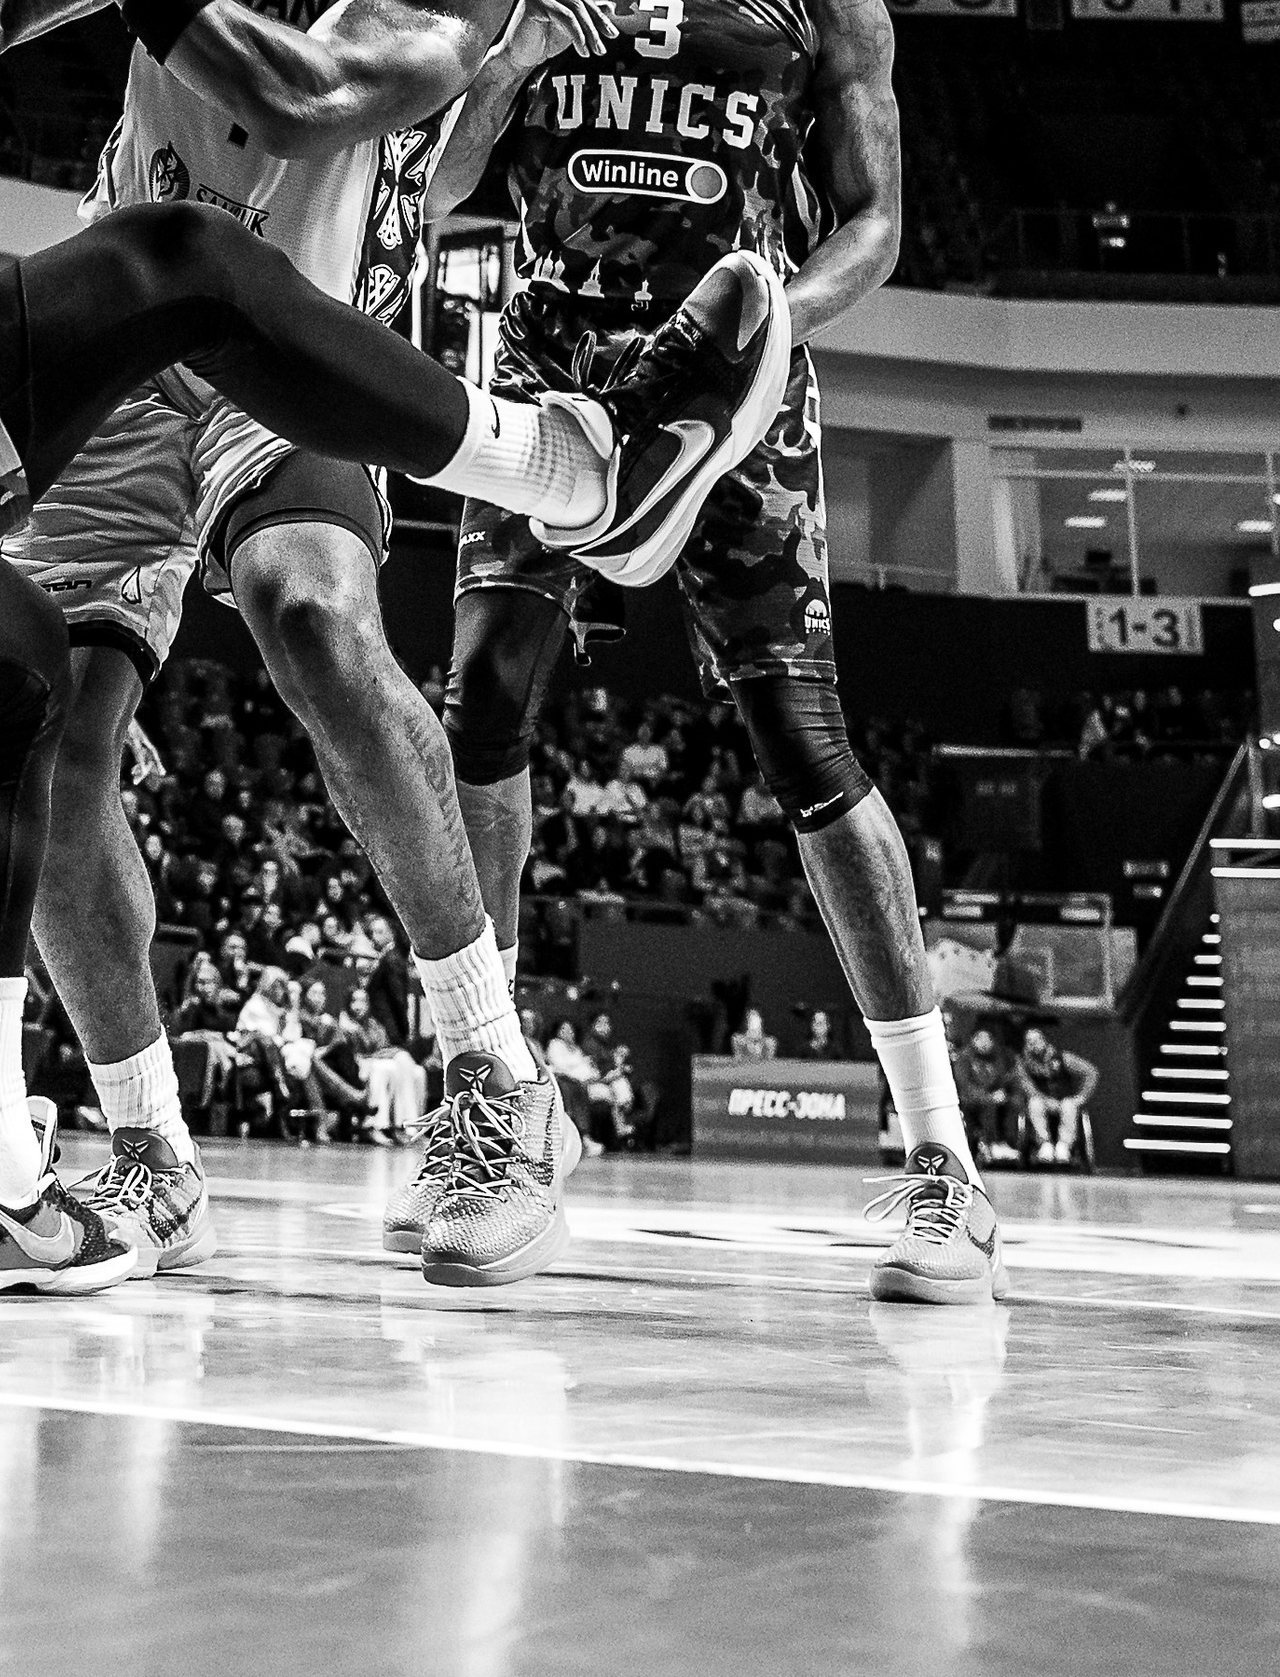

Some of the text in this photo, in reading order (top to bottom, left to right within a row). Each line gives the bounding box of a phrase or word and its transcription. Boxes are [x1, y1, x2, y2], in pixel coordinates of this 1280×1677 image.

[552, 74, 760, 150] UNICS
[581, 159, 680, 189] Winline
[1108, 607, 1181, 647] 1-3
[728, 1088, 846, 1121] ПРЕСС-ЗОНА
